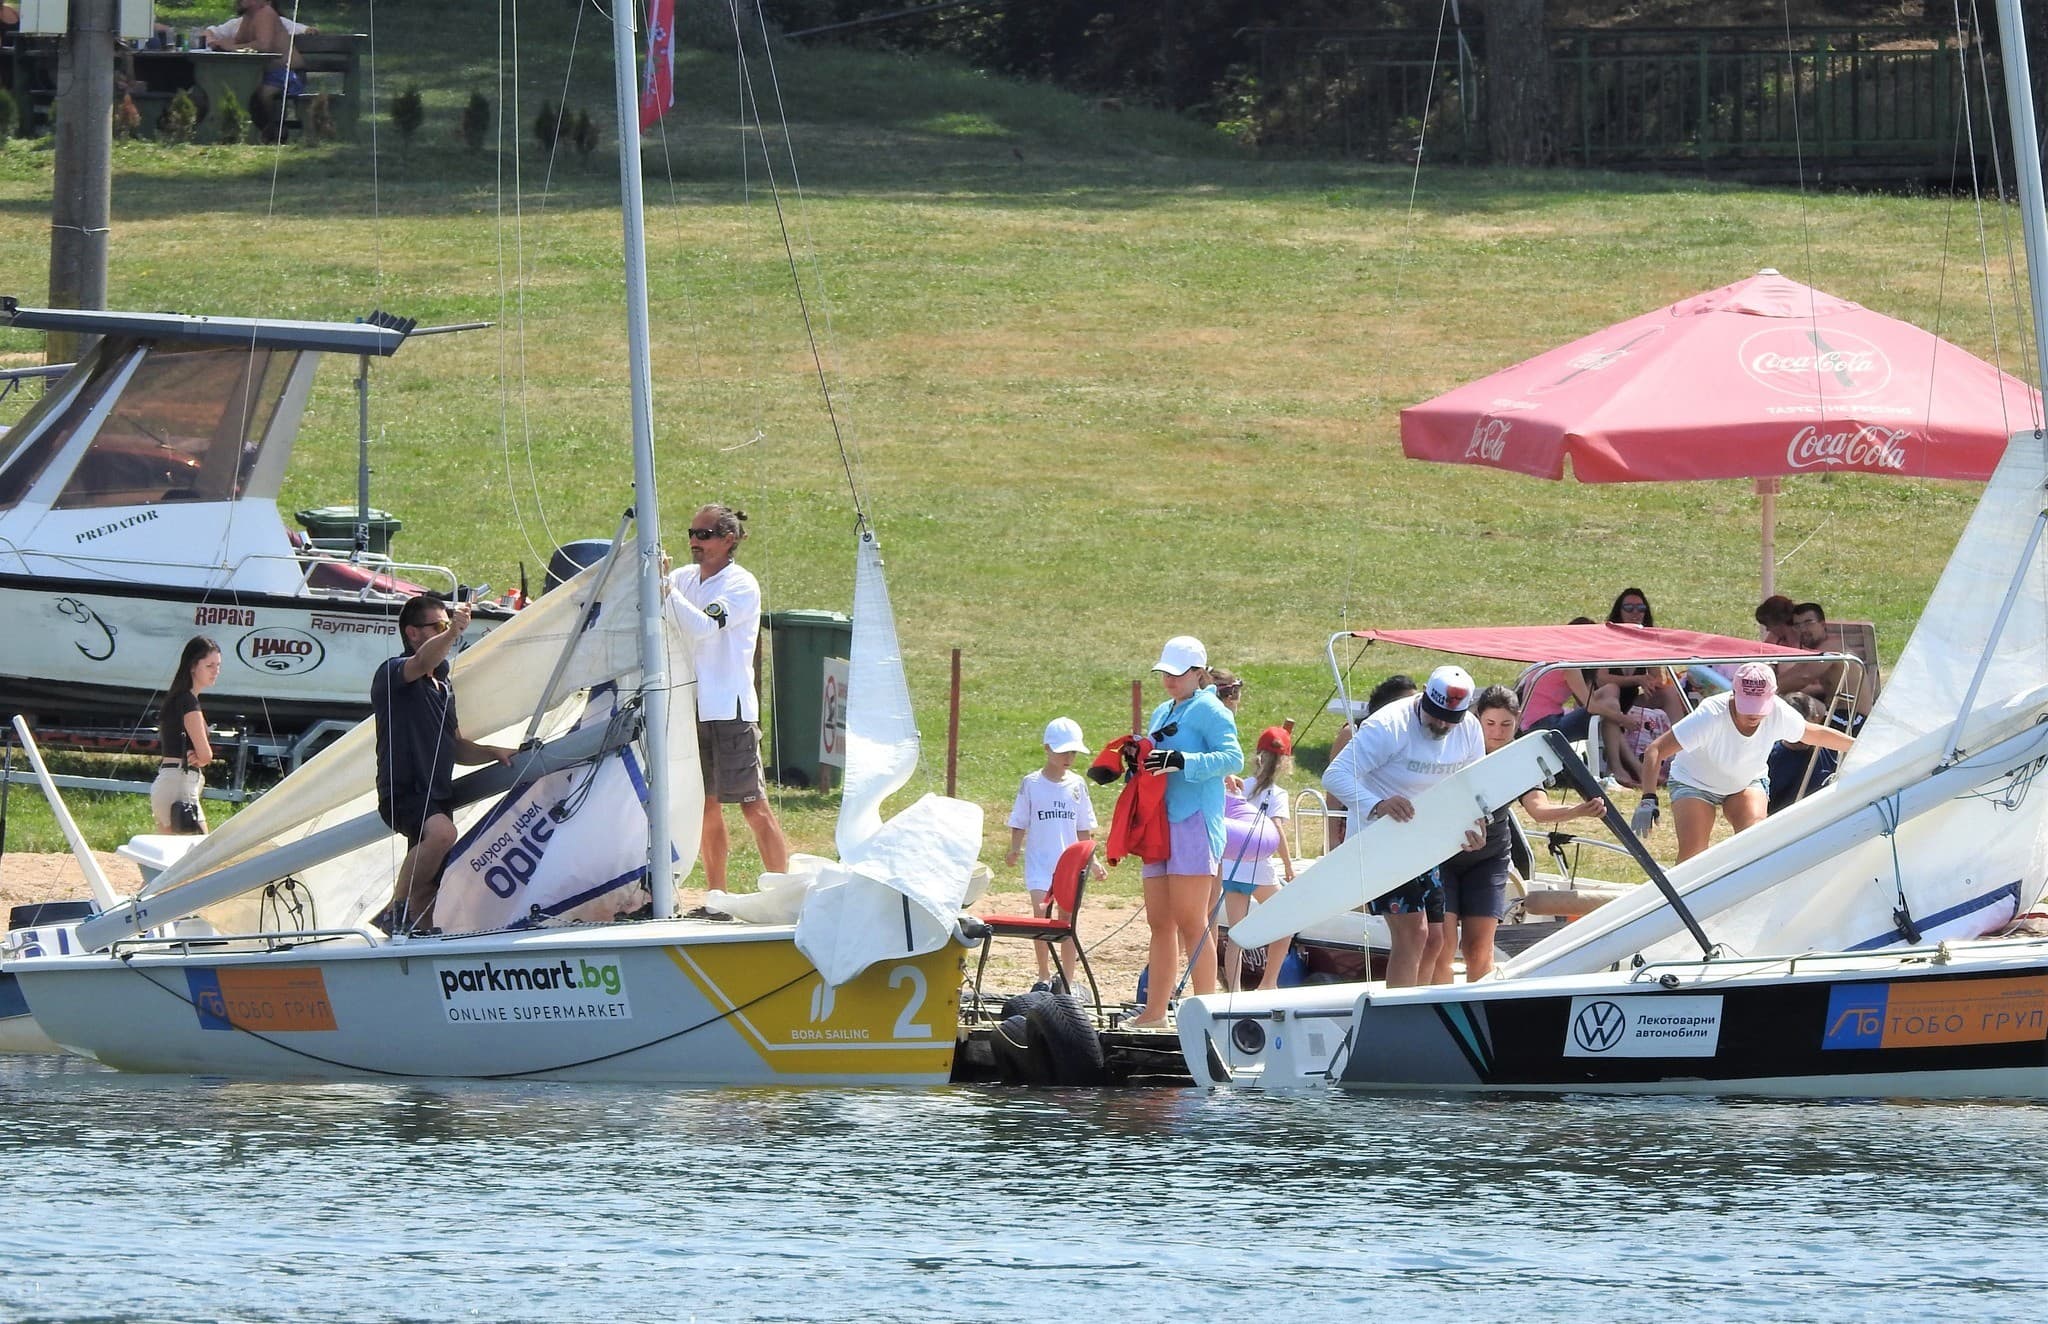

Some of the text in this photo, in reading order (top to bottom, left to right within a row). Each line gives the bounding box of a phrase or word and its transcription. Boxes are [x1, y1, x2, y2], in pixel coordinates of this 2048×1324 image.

[75, 509, 159, 544] PREDATOR
[194, 606, 256, 627] Rapala
[311, 617, 397, 636] Raymarine
[252, 637, 313, 658] HALCO
[470, 800, 543, 873] yacht booking
[440, 959, 621, 1000] parkmart.bg
[449, 1003, 625, 1021] ONLINE SUPERMARKET
[888, 965, 932, 1039] 2
[1637, 1015, 1715, 1027] Лекотоварни
[1891, 1010, 2043, 1035] ТОБО ГРУП
[791, 1029, 869, 1040] BORA SAILING
[1635, 1028, 1708, 1038] автомобили
